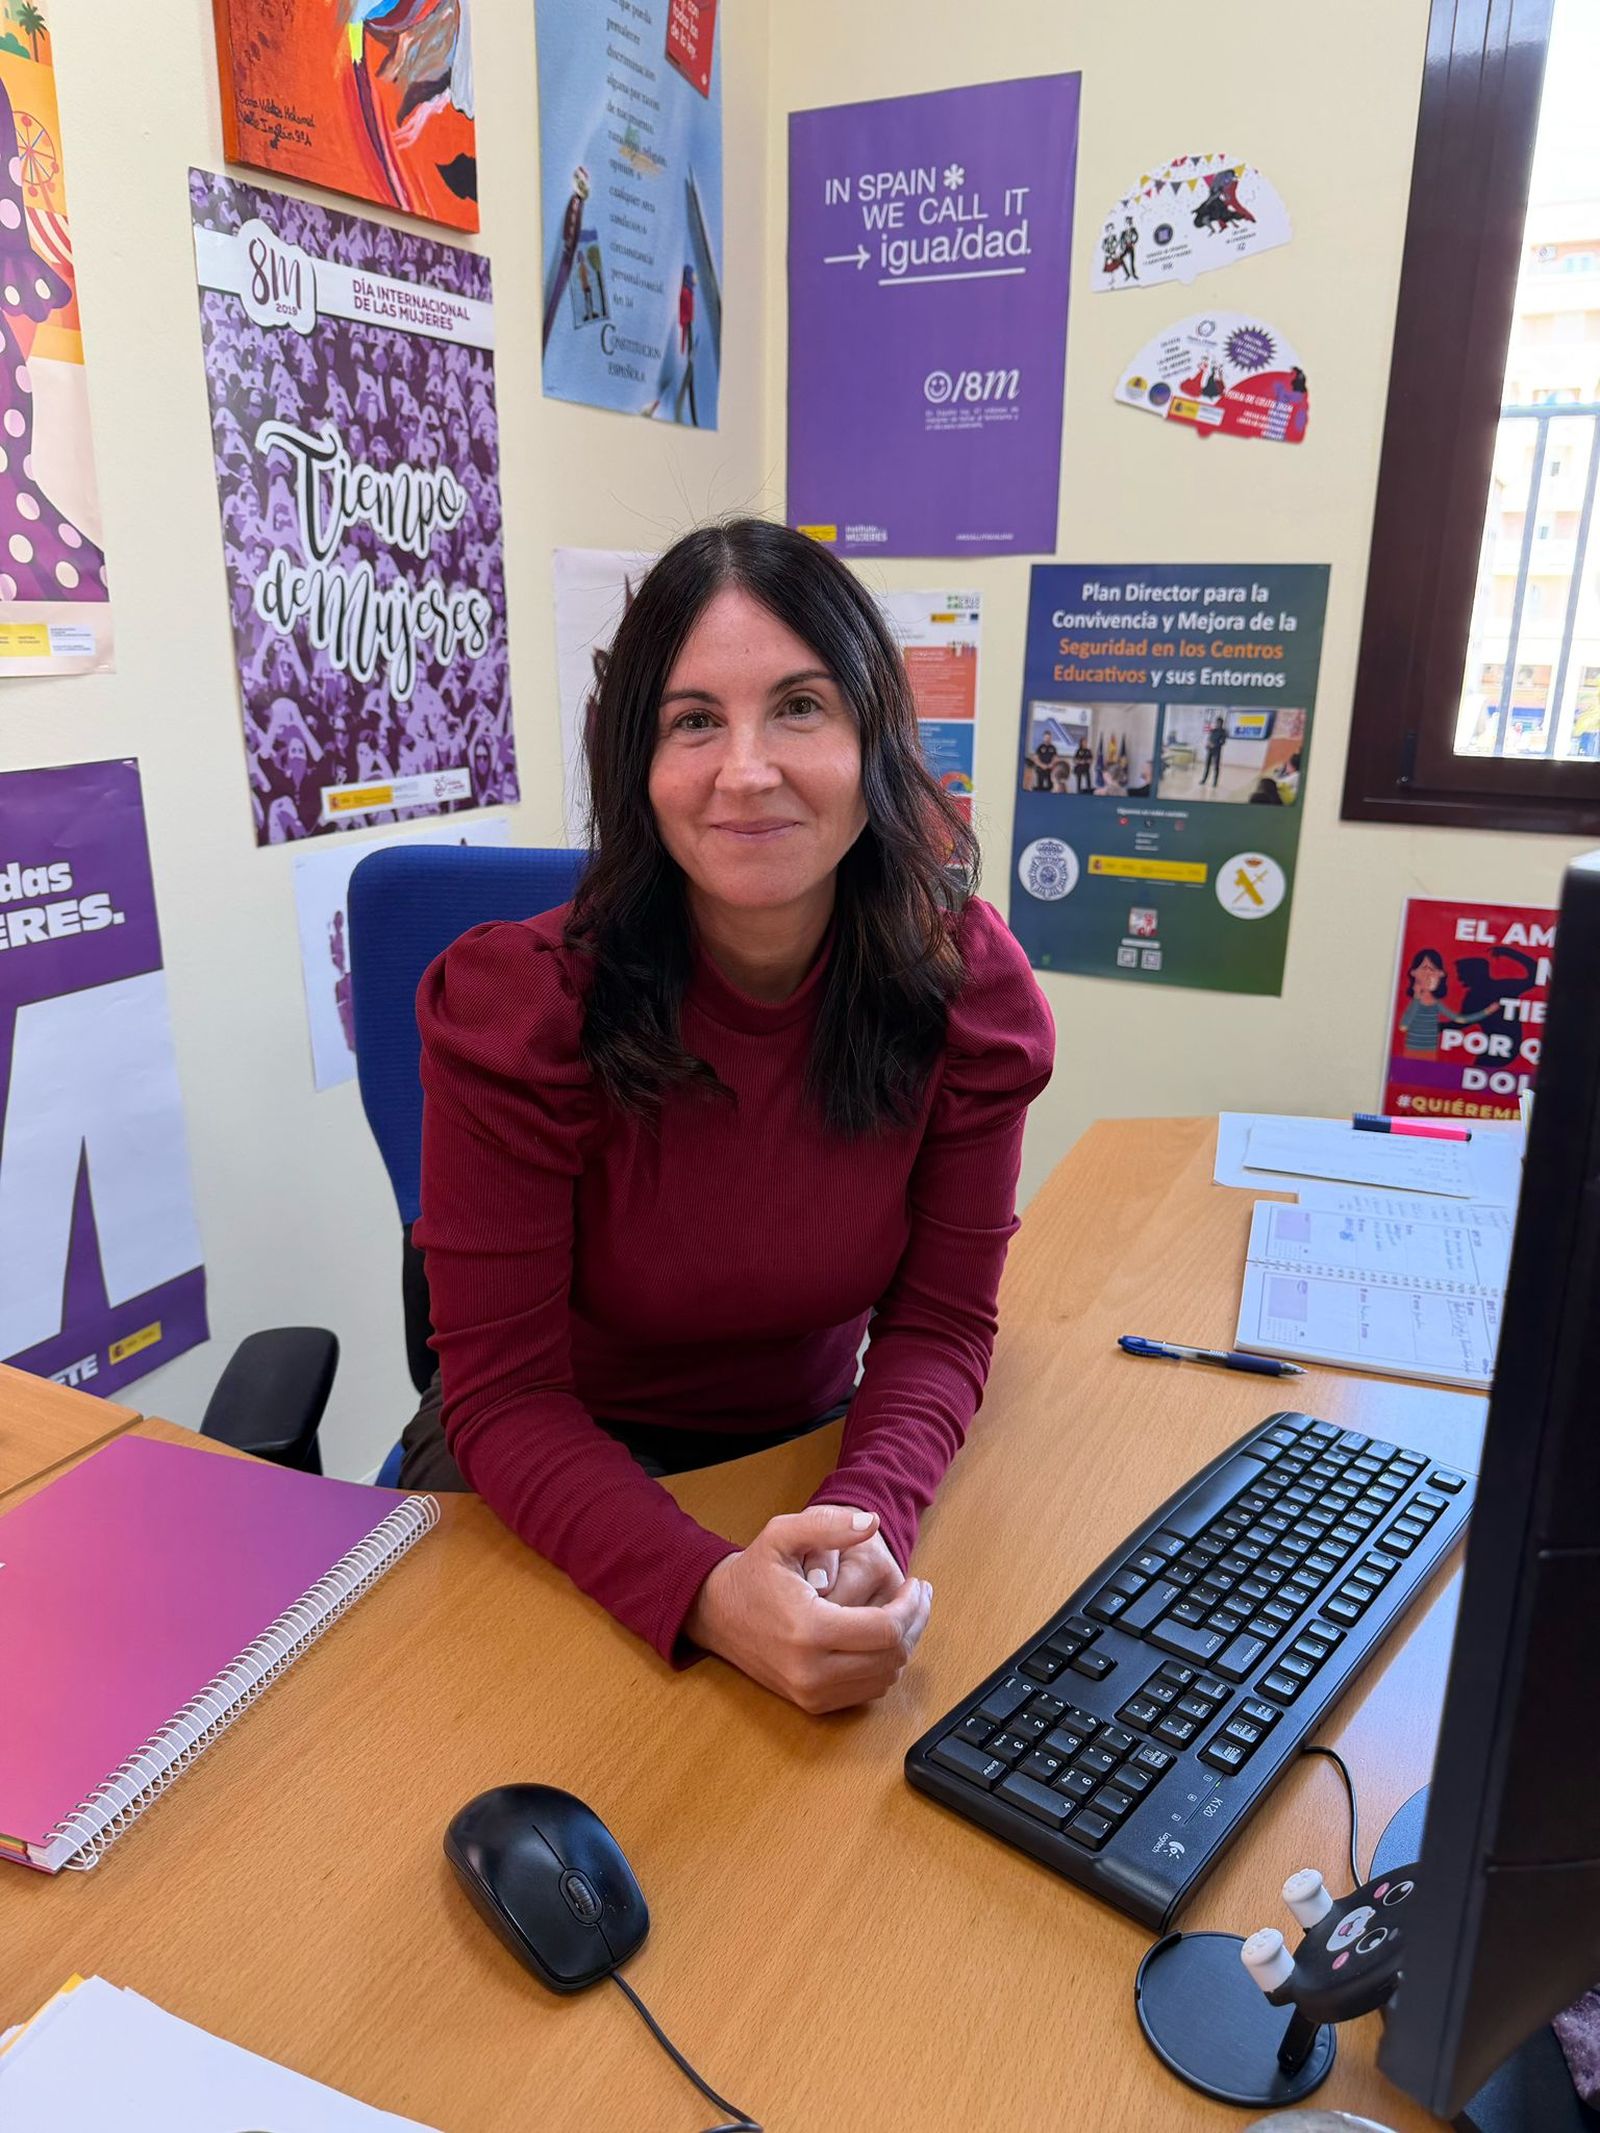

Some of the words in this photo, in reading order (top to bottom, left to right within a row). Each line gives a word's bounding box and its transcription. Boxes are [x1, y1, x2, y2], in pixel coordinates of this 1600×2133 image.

[825, 177, 850, 205] IN
[858, 166, 936, 201] SPAIN
[862, 201, 904, 230] WE
[919, 193, 988, 225] CALL
[1004, 188, 1030, 217] IT
[352, 278, 374, 298] DÍA
[376, 286, 470, 321] INTERNACIONAL
[354, 297, 371, 311] DE
[373, 301, 396, 318] LAS
[400, 306, 454, 331] MUJERES
[261, 428, 465, 563] Tiempo
[1082, 583, 1120, 602] Plan
[1125, 583, 1200, 602] Director
[1203, 586, 1246, 605] para
[1251, 583, 1269, 602] la
[306, 568, 488, 695] Mujeres
[1052, 609, 1157, 630] Convivencia
[1162, 615, 1175, 633] y
[1177, 611, 1245, 633] Mejora
[1249, 612, 1274, 631] de
[1279, 612, 1297, 632] la
[1059, 638, 1148, 659] Seguridad
[1152, 644, 1175, 657] en
[1180, 639, 1205, 658] los
[1211, 640, 1284, 659] Centros
[1053, 665, 1146, 683] Educativos
[1151, 670, 1163, 688] y
[1166, 669, 1196, 685] sus
[1200, 668, 1286, 688] Entornos
[0, 892, 125, 951] RES.
[1455, 918, 1496, 943] EL
[1441, 1029, 1513, 1058] POR
[1163, 1690, 1173, 1700] Fin
[1149, 1750, 1161, 1763] Num
[1203, 1797, 1223, 1817] K120
[1152, 1832, 1172, 1853] Logitech
